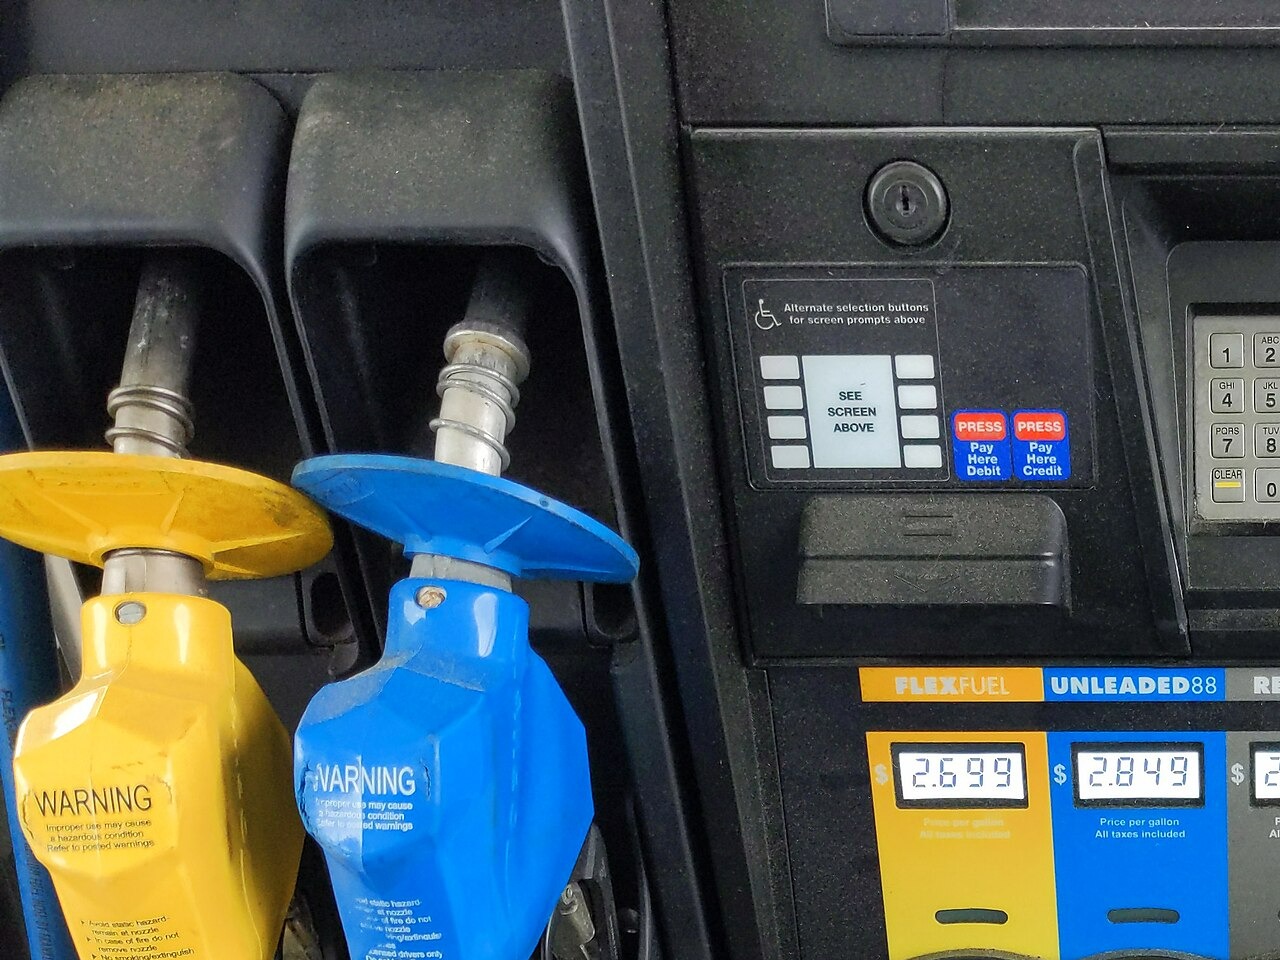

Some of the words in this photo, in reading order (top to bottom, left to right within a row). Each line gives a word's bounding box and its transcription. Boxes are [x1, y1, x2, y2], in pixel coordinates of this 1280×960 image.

[784, 303, 833, 312] Alternate
[836, 303, 886, 312] selection
[888, 303, 929, 312] buttons
[790, 316, 805, 324] for
[808, 317, 844, 325] screen
[847, 316, 891, 327] prompts
[894, 316, 926, 325] above
[1261, 336, 1280, 344] ABC
[1223, 348, 1230, 363] 1
[1265, 348, 1276, 363] 2
[839, 391, 862, 401] SEE
[1222, 393, 1232, 407] 4
[1265, 393, 1276, 408] 5
[828, 407, 876, 417] SCREEN
[834, 423, 874, 433] ABOVE
[958, 422, 1002, 433] PRESS
[1018, 422, 1062, 433] PRESS
[1216, 427, 1239, 435] PQRS
[1264, 427, 1279, 435] TUV
[970, 442, 994, 455] Pay
[1029, 442, 1053, 455] Pay
[1222, 438, 1233, 453] 7
[1266, 438, 1276, 453] 8
[968, 454, 998, 464] Here
[1027, 454, 1057, 464] Here
[967, 465, 1001, 476] Debit
[1023, 465, 1062, 476] Credit
[1214, 470, 1243, 479] CLEAR
[1267, 483, 1277, 497] 0
[895, 676, 1010, 695] FLEXFUEL
[912, 758, 1012, 788] 2.699
[1089, 757, 1188, 787] 2.849
[313, 763, 416, 796] WARNING
[34, 784, 153, 817] WARNING
[368, 802, 386, 812] may
[387, 802, 413, 810] cause
[367, 811, 405, 821] condition
[104, 821, 122, 830] may
[125, 819, 152, 827] cause
[1100, 817, 1126, 827] Price
[1128, 819, 1145, 829] per
[1148, 817, 1180, 829] gallon
[104, 829, 144, 840] condition
[1095, 829, 1109, 839] All
[1111, 830, 1139, 839] taxes
[1142, 829, 1186, 839] included
